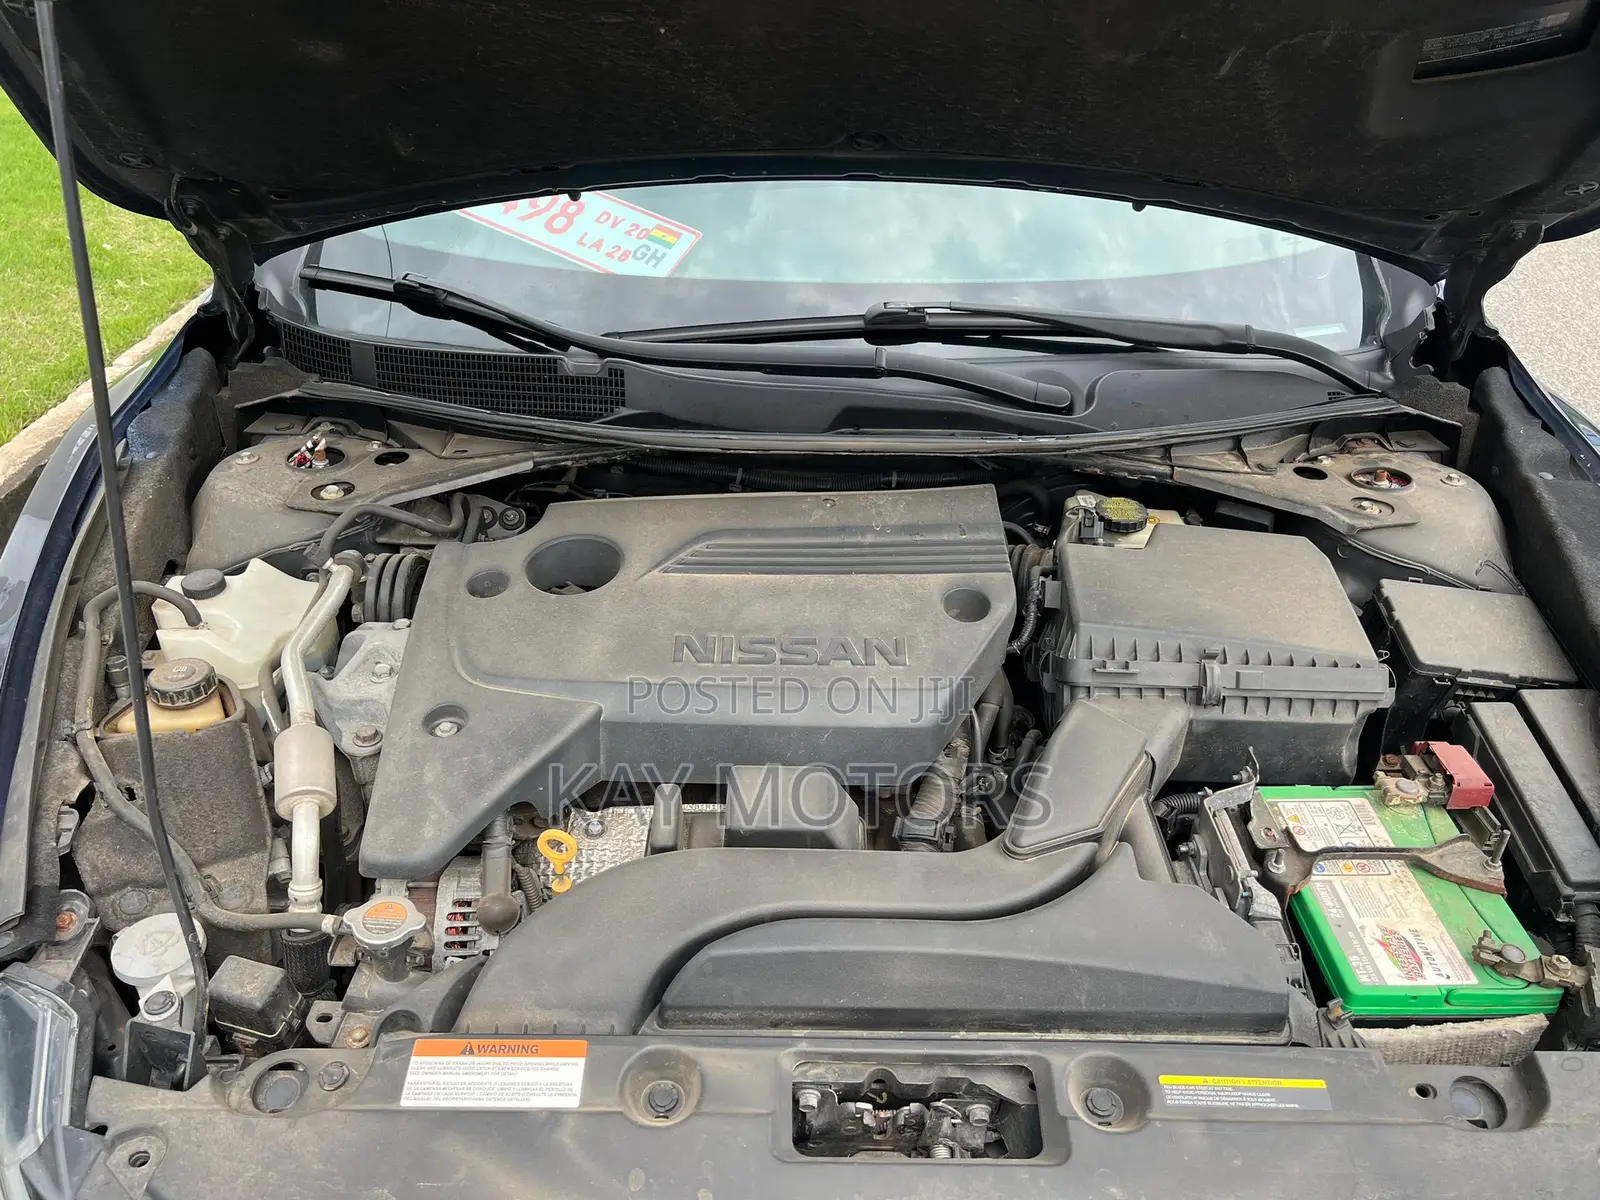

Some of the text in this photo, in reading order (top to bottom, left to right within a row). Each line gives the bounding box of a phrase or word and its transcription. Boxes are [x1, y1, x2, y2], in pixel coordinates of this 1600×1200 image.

[595, 210, 651, 241] DV 20
[576, 232, 605, 253] LA
[632, 244, 667, 269] GH
[672, 637, 909, 666] NISSAN
[1379, 926, 1415, 981] INTERSTATE
[1390, 929, 1423, 977] BATTERIES
[1408, 927, 1444, 977] AUTOMOTIVE
[477, 1044, 539, 1054] WARNING
